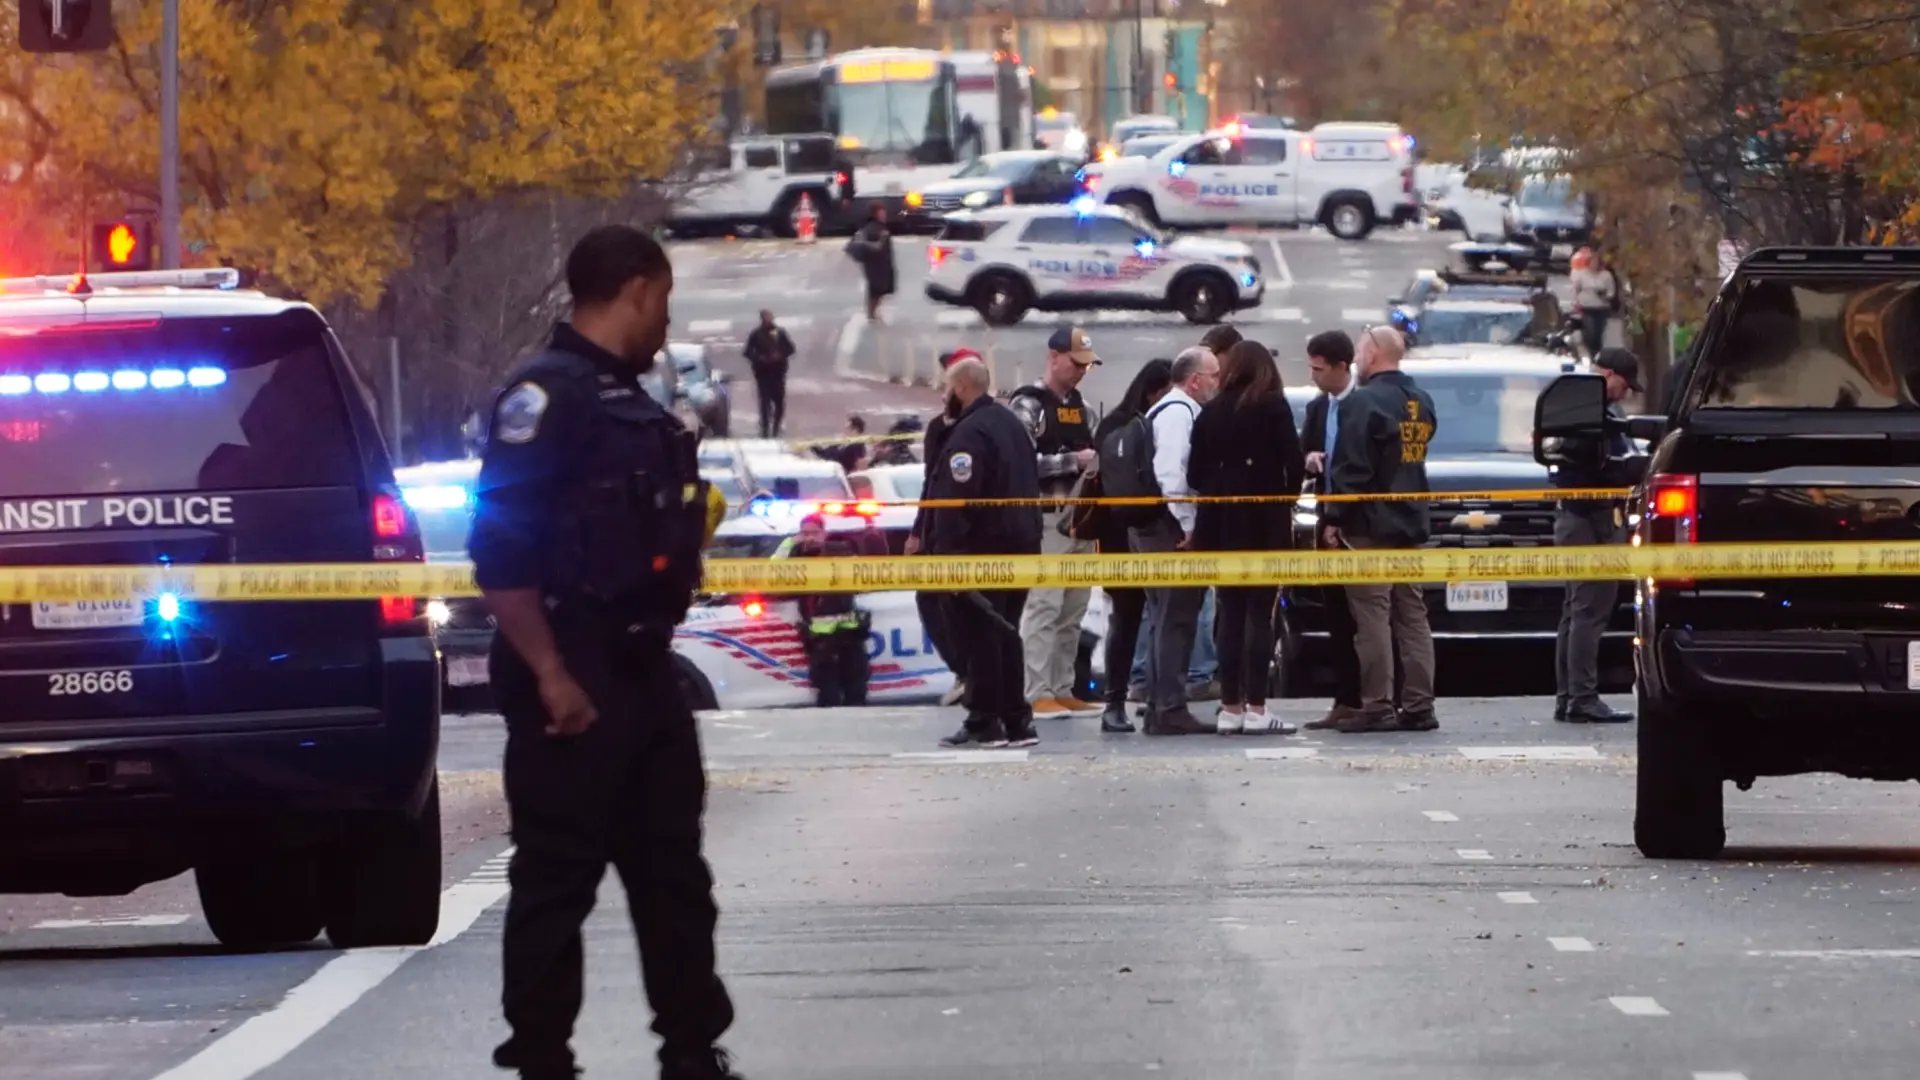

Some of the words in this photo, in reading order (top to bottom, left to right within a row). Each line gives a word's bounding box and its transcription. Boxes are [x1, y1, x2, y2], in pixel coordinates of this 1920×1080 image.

[1200, 183, 1279, 197] POLICE
[1029, 258, 1119, 276] POLICE
[0, 499, 88, 531] NSIT
[103, 496, 234, 527] POLICE
[1058, 561, 1099, 583] POLICE
[1101, 560, 1127, 582] LINE
[1131, 559, 1148, 581] DO
[1151, 559, 1175, 581] NOT
[1180, 558, 1220, 580] CROSS
[1262, 557, 1303, 579] POLICE
[1305, 556, 1332, 578] LINE
[1336, 556, 1353, 578] DO
[1356, 556, 1380, 578] NOT
[1385, 555, 1425, 577] CROSS
[1468, 555, 1511, 577] POLICE
[1514, 554, 1542, 576] LINE
[1768, 552, 1789, 572] NOT
[1794, 551, 1835, 571] CROSS
[240, 571, 281, 593] POLICE
[768, 564, 809, 587] CROSS
[852, 563, 894, 586] POLICE
[898, 562, 923, 585] LINE
[926, 562, 943, 585] DO
[947, 562, 969, 585] NOT
[974, 561, 1015, 584] CROSS
[48, 670, 134, 696] 28666
